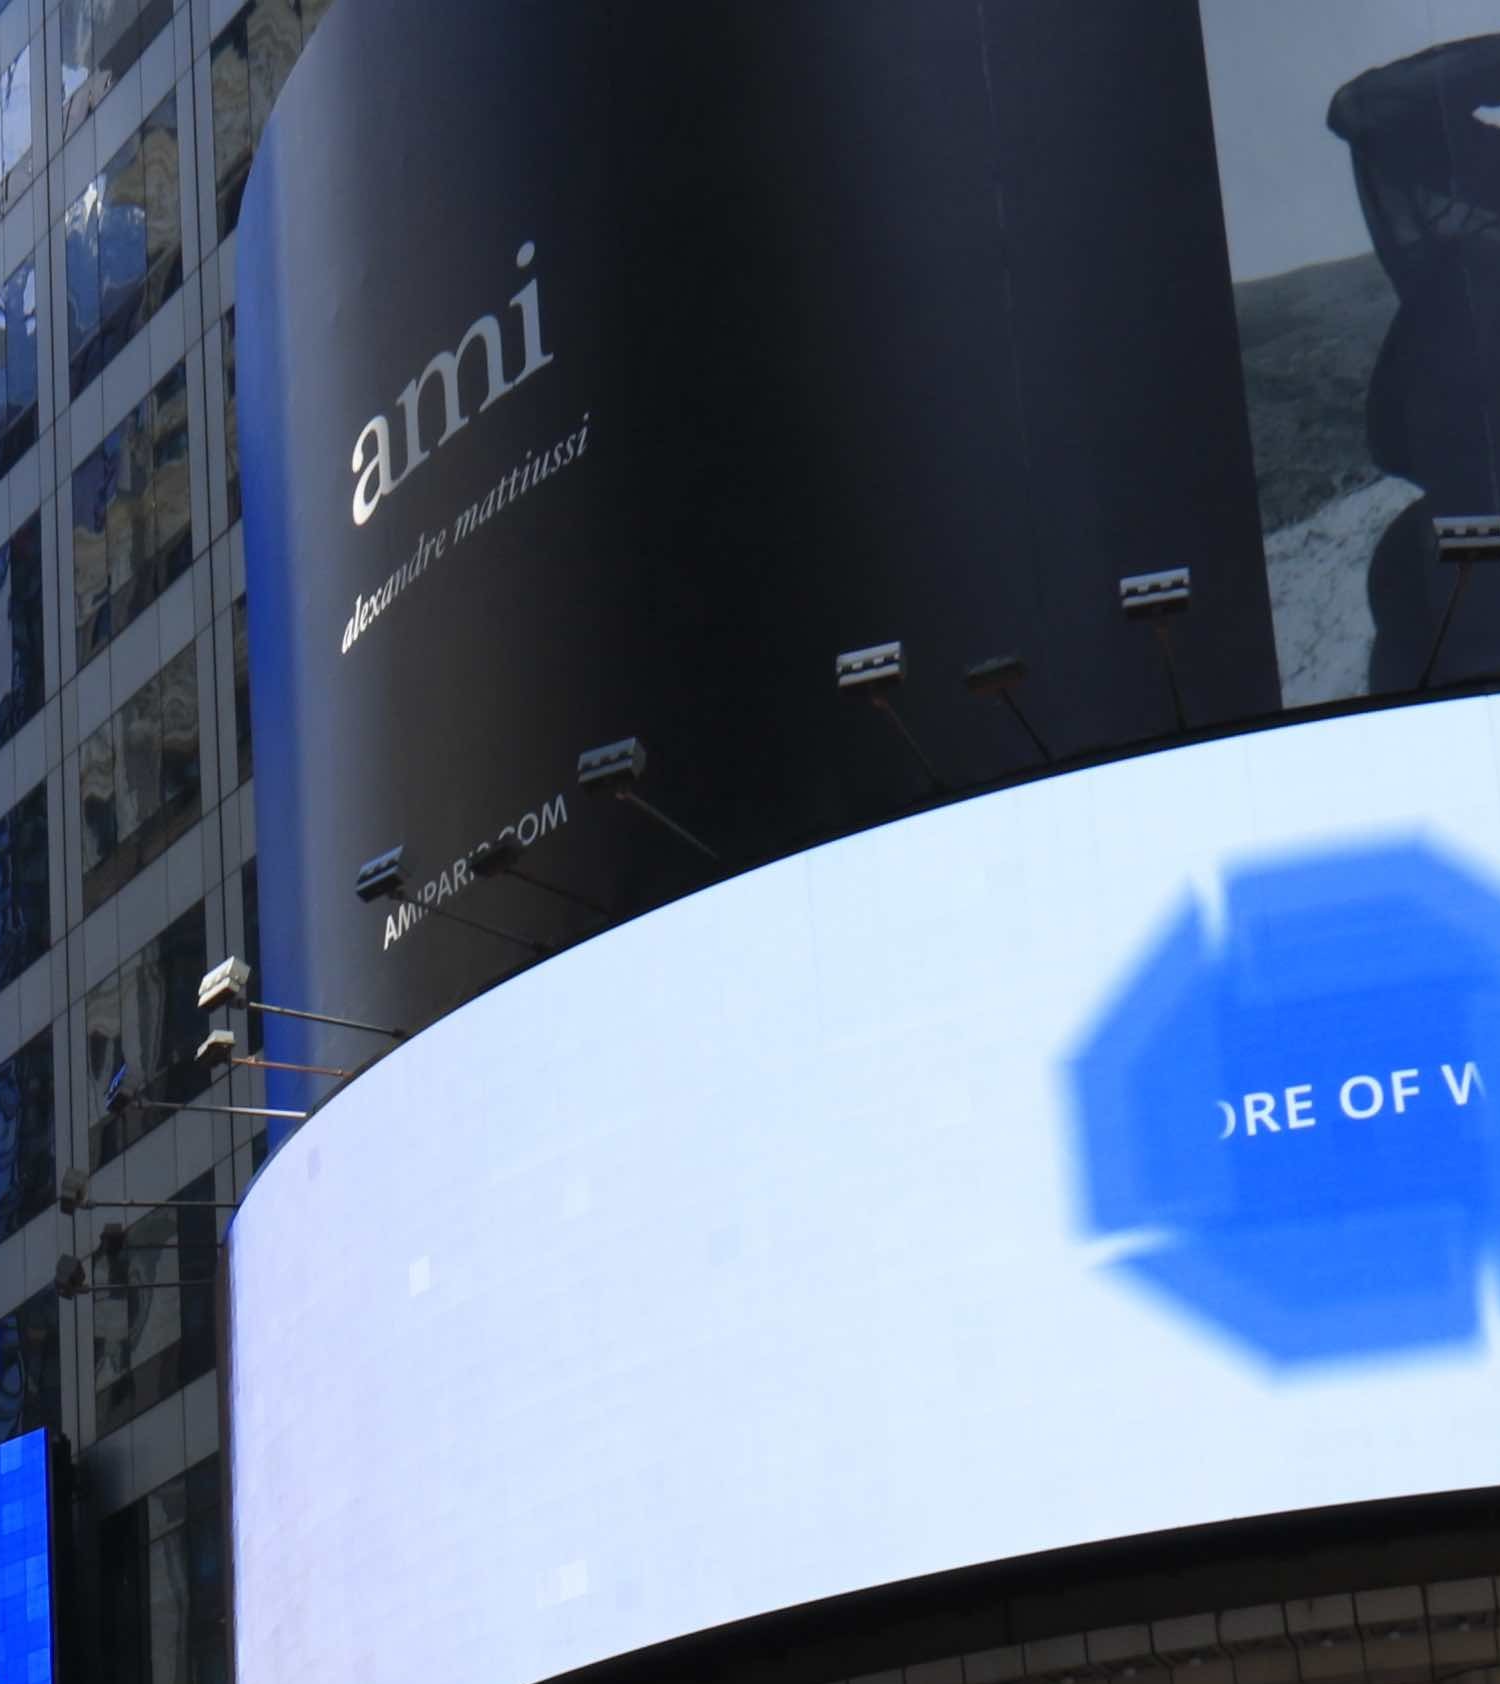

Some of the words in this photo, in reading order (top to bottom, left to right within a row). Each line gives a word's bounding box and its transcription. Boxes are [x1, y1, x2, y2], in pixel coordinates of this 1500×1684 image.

[351, 240, 554, 527] ami
[342, 520, 448, 656] alexandre
[452, 413, 592, 540] mattiussi
[1339, 1068, 1421, 1119] OF
